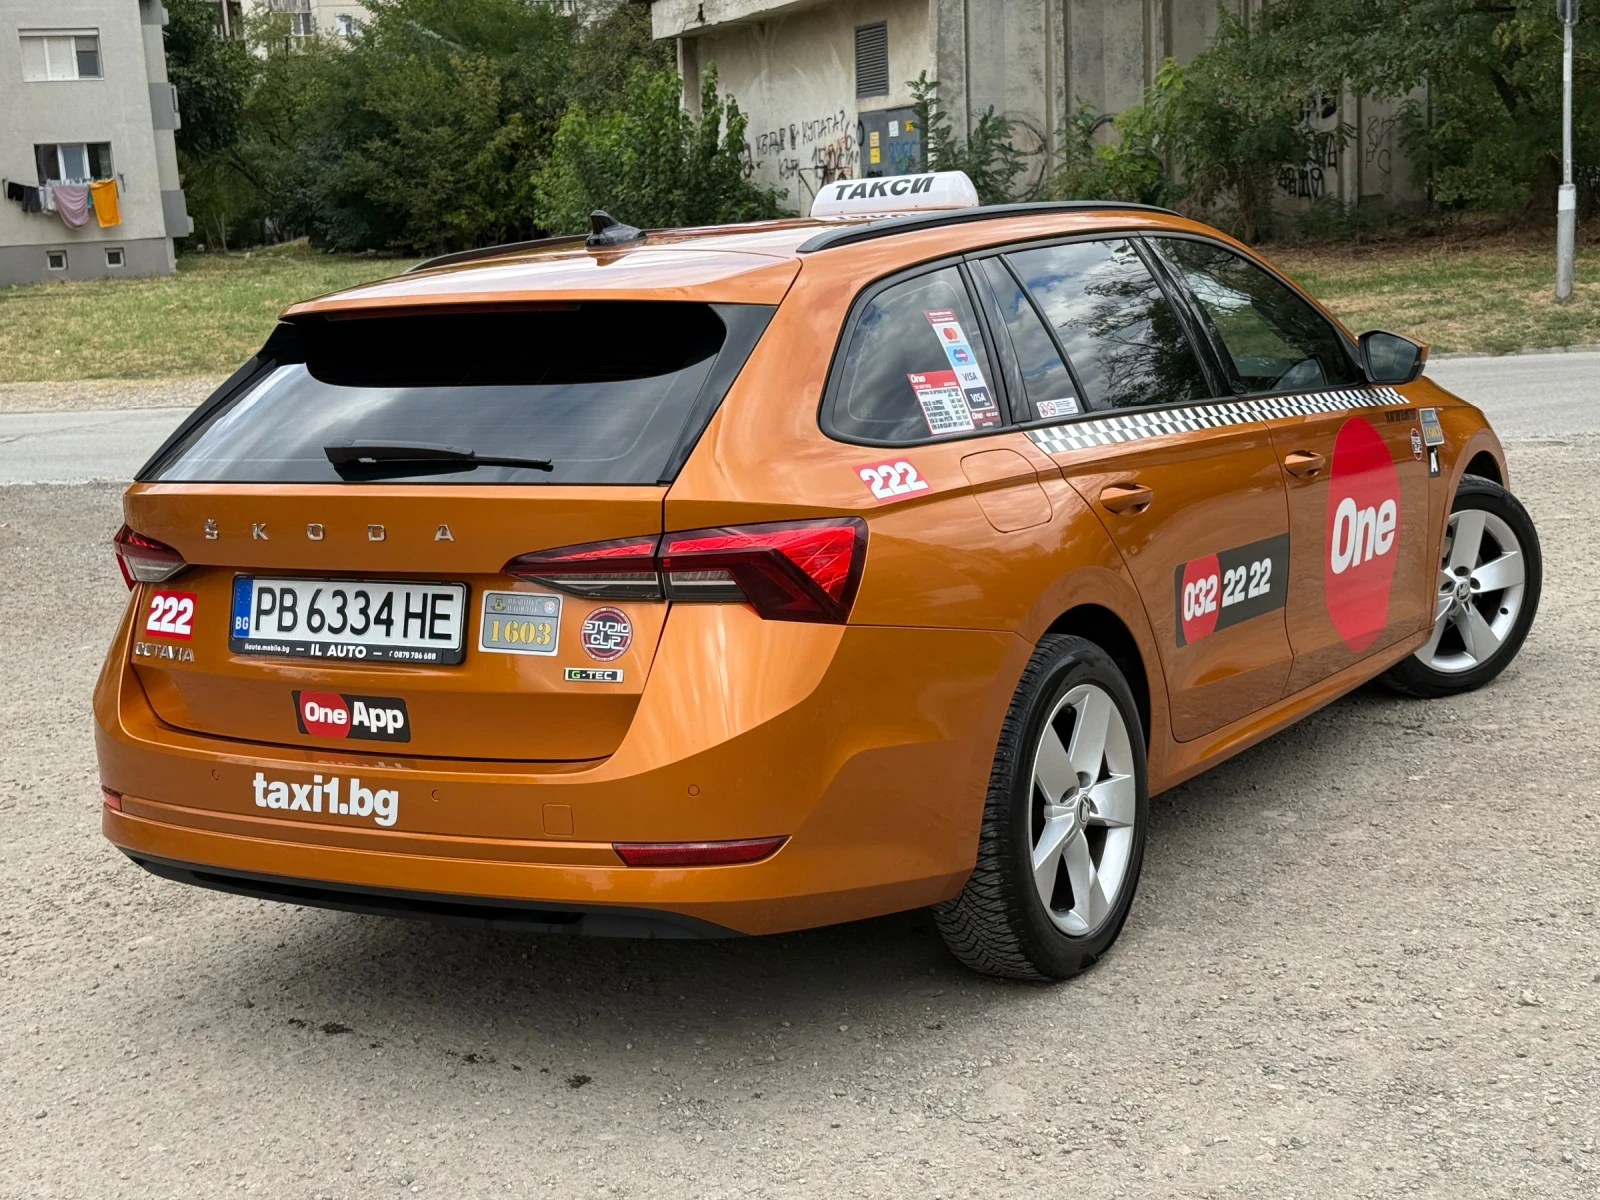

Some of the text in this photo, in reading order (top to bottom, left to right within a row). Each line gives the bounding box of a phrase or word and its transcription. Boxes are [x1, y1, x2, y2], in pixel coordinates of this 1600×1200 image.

[835, 176, 935, 201] ТАКСИ
[910, 374, 926, 383] One
[962, 371, 978, 381] VISA
[970, 393, 987, 403] VISA
[859, 461, 929, 499] 222
[204, 519, 455, 542] ŠKODA
[1331, 497, 1397, 575] One
[1183, 557, 1272, 622] 032 22 22
[146, 595, 194, 635] 222
[235, 616, 249, 631] BG
[306, 588, 395, 638] 6334
[402, 591, 454, 641] HE
[490, 619, 552, 645] 1603
[584, 620, 629, 636] STUDIO
[135, 642, 195, 662] OCTAVIA
[310, 643, 367, 659] IL AUTO
[304, 701, 405, 734] One App
[253, 772, 399, 827] taxi1.bg
